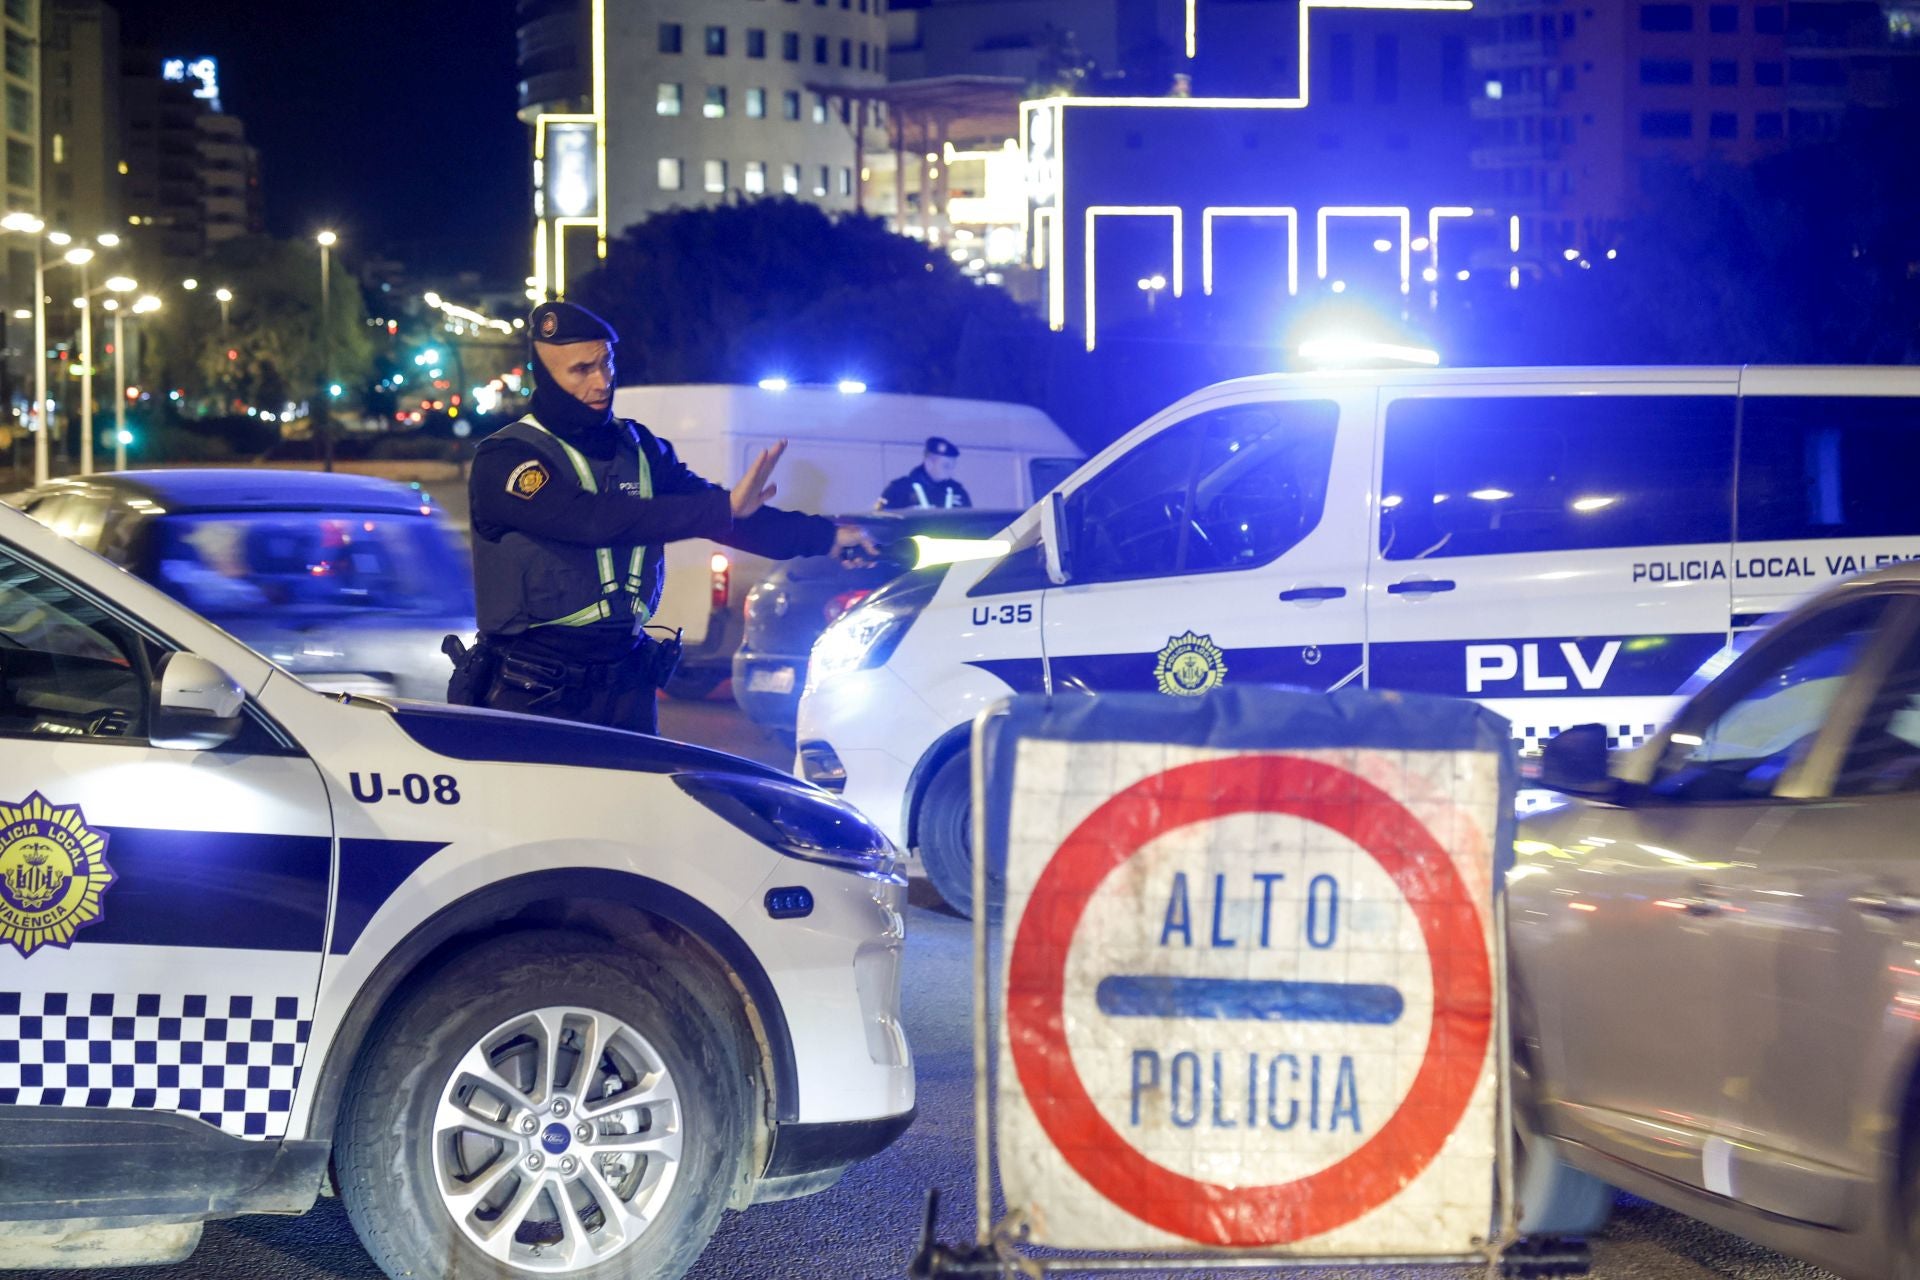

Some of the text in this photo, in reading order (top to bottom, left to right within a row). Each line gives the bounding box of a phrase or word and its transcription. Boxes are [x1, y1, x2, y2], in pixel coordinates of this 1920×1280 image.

[1633, 560, 1727, 582] POLICIA
[1736, 557, 1815, 578] LOCAL
[973, 604, 1032, 626] U-35
[1466, 641, 1622, 692] PLV
[349, 772, 461, 805] U-08
[47, 826, 85, 867] LOCAL
[0, 901, 67, 928] VALENCIA
[1159, 871, 1339, 949] ALTO
[1129, 1048, 1362, 1132] POLICIA
